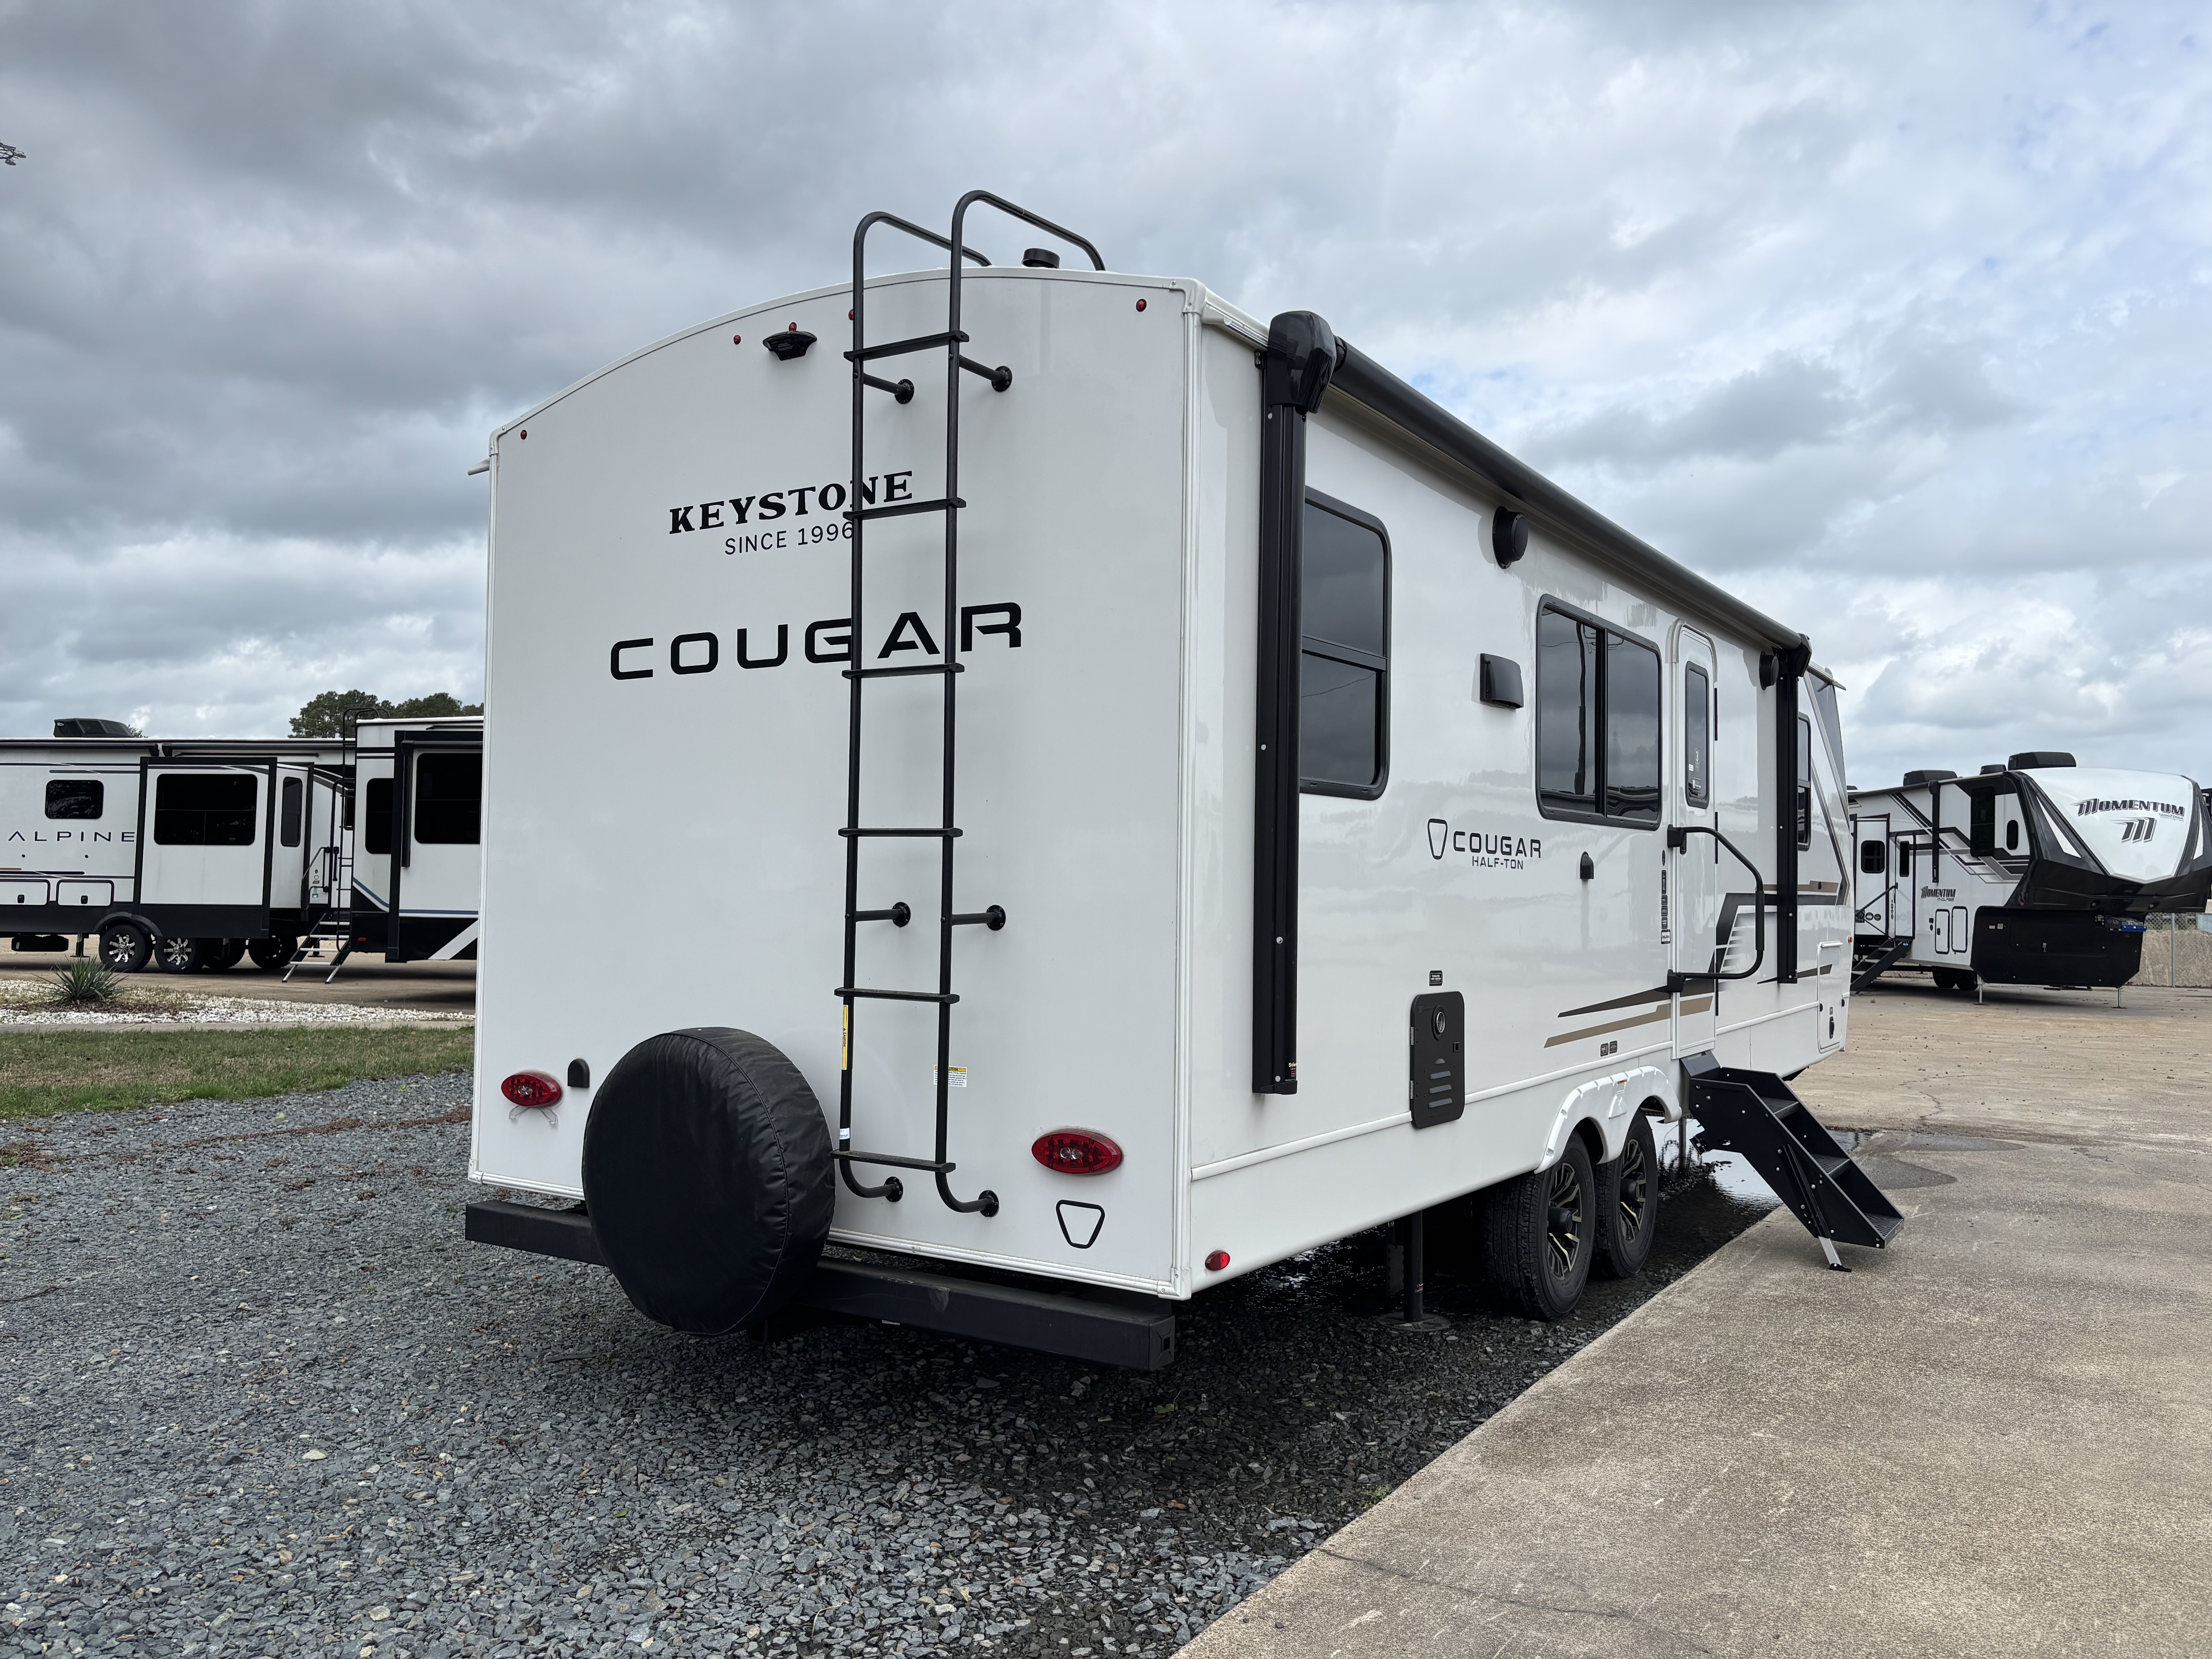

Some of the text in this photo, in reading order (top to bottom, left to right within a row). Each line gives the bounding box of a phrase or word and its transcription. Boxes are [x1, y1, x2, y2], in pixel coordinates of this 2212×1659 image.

[670, 471, 912, 534] KEYSTONE
[725, 521, 852, 555] SINCE 1996
[611, 602, 1021, 680] COUGAR
[2071, 798, 2185, 816] MOMENTUM
[8, 831, 135, 842] ALPINE
[1453, 831, 1541, 858] COUGAR
[1472, 856, 1523, 870] HALF-TON
